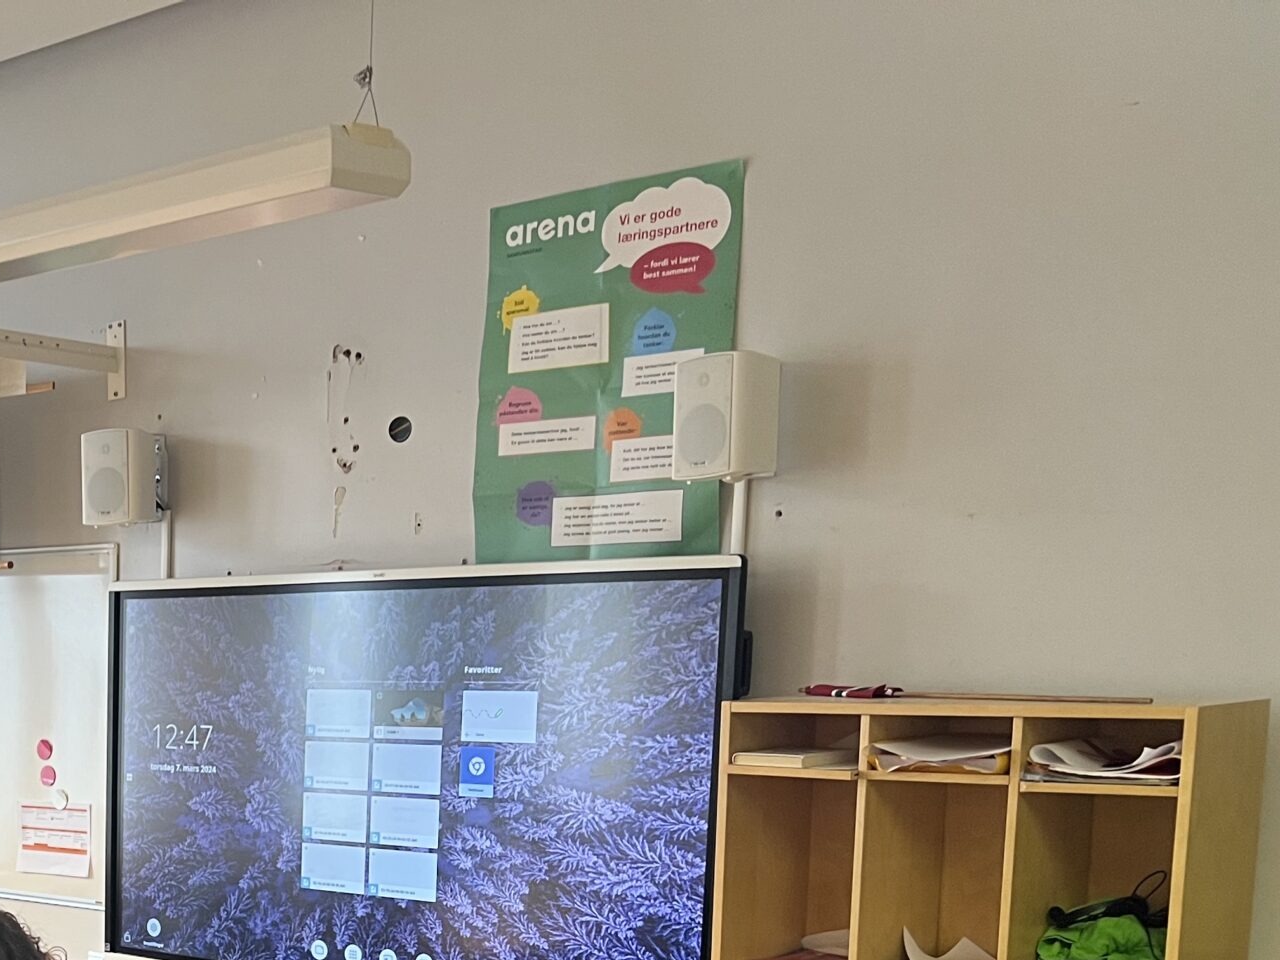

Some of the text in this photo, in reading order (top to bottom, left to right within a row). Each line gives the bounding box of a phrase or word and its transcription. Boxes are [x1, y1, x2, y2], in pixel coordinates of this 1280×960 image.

[619, 206, 682, 226] Vi er gode
[506, 210, 596, 247] arena
[618, 218, 719, 244] læringspartnere
[650, 258, 669, 269] fordi
[670, 257, 678, 265] vi
[643, 268, 660, 279] best
[464, 665, 503, 674] Favoritter
[153, 723, 213, 750] 12:47
[150, 763, 217, 774] torsdag 7. mars 2024
